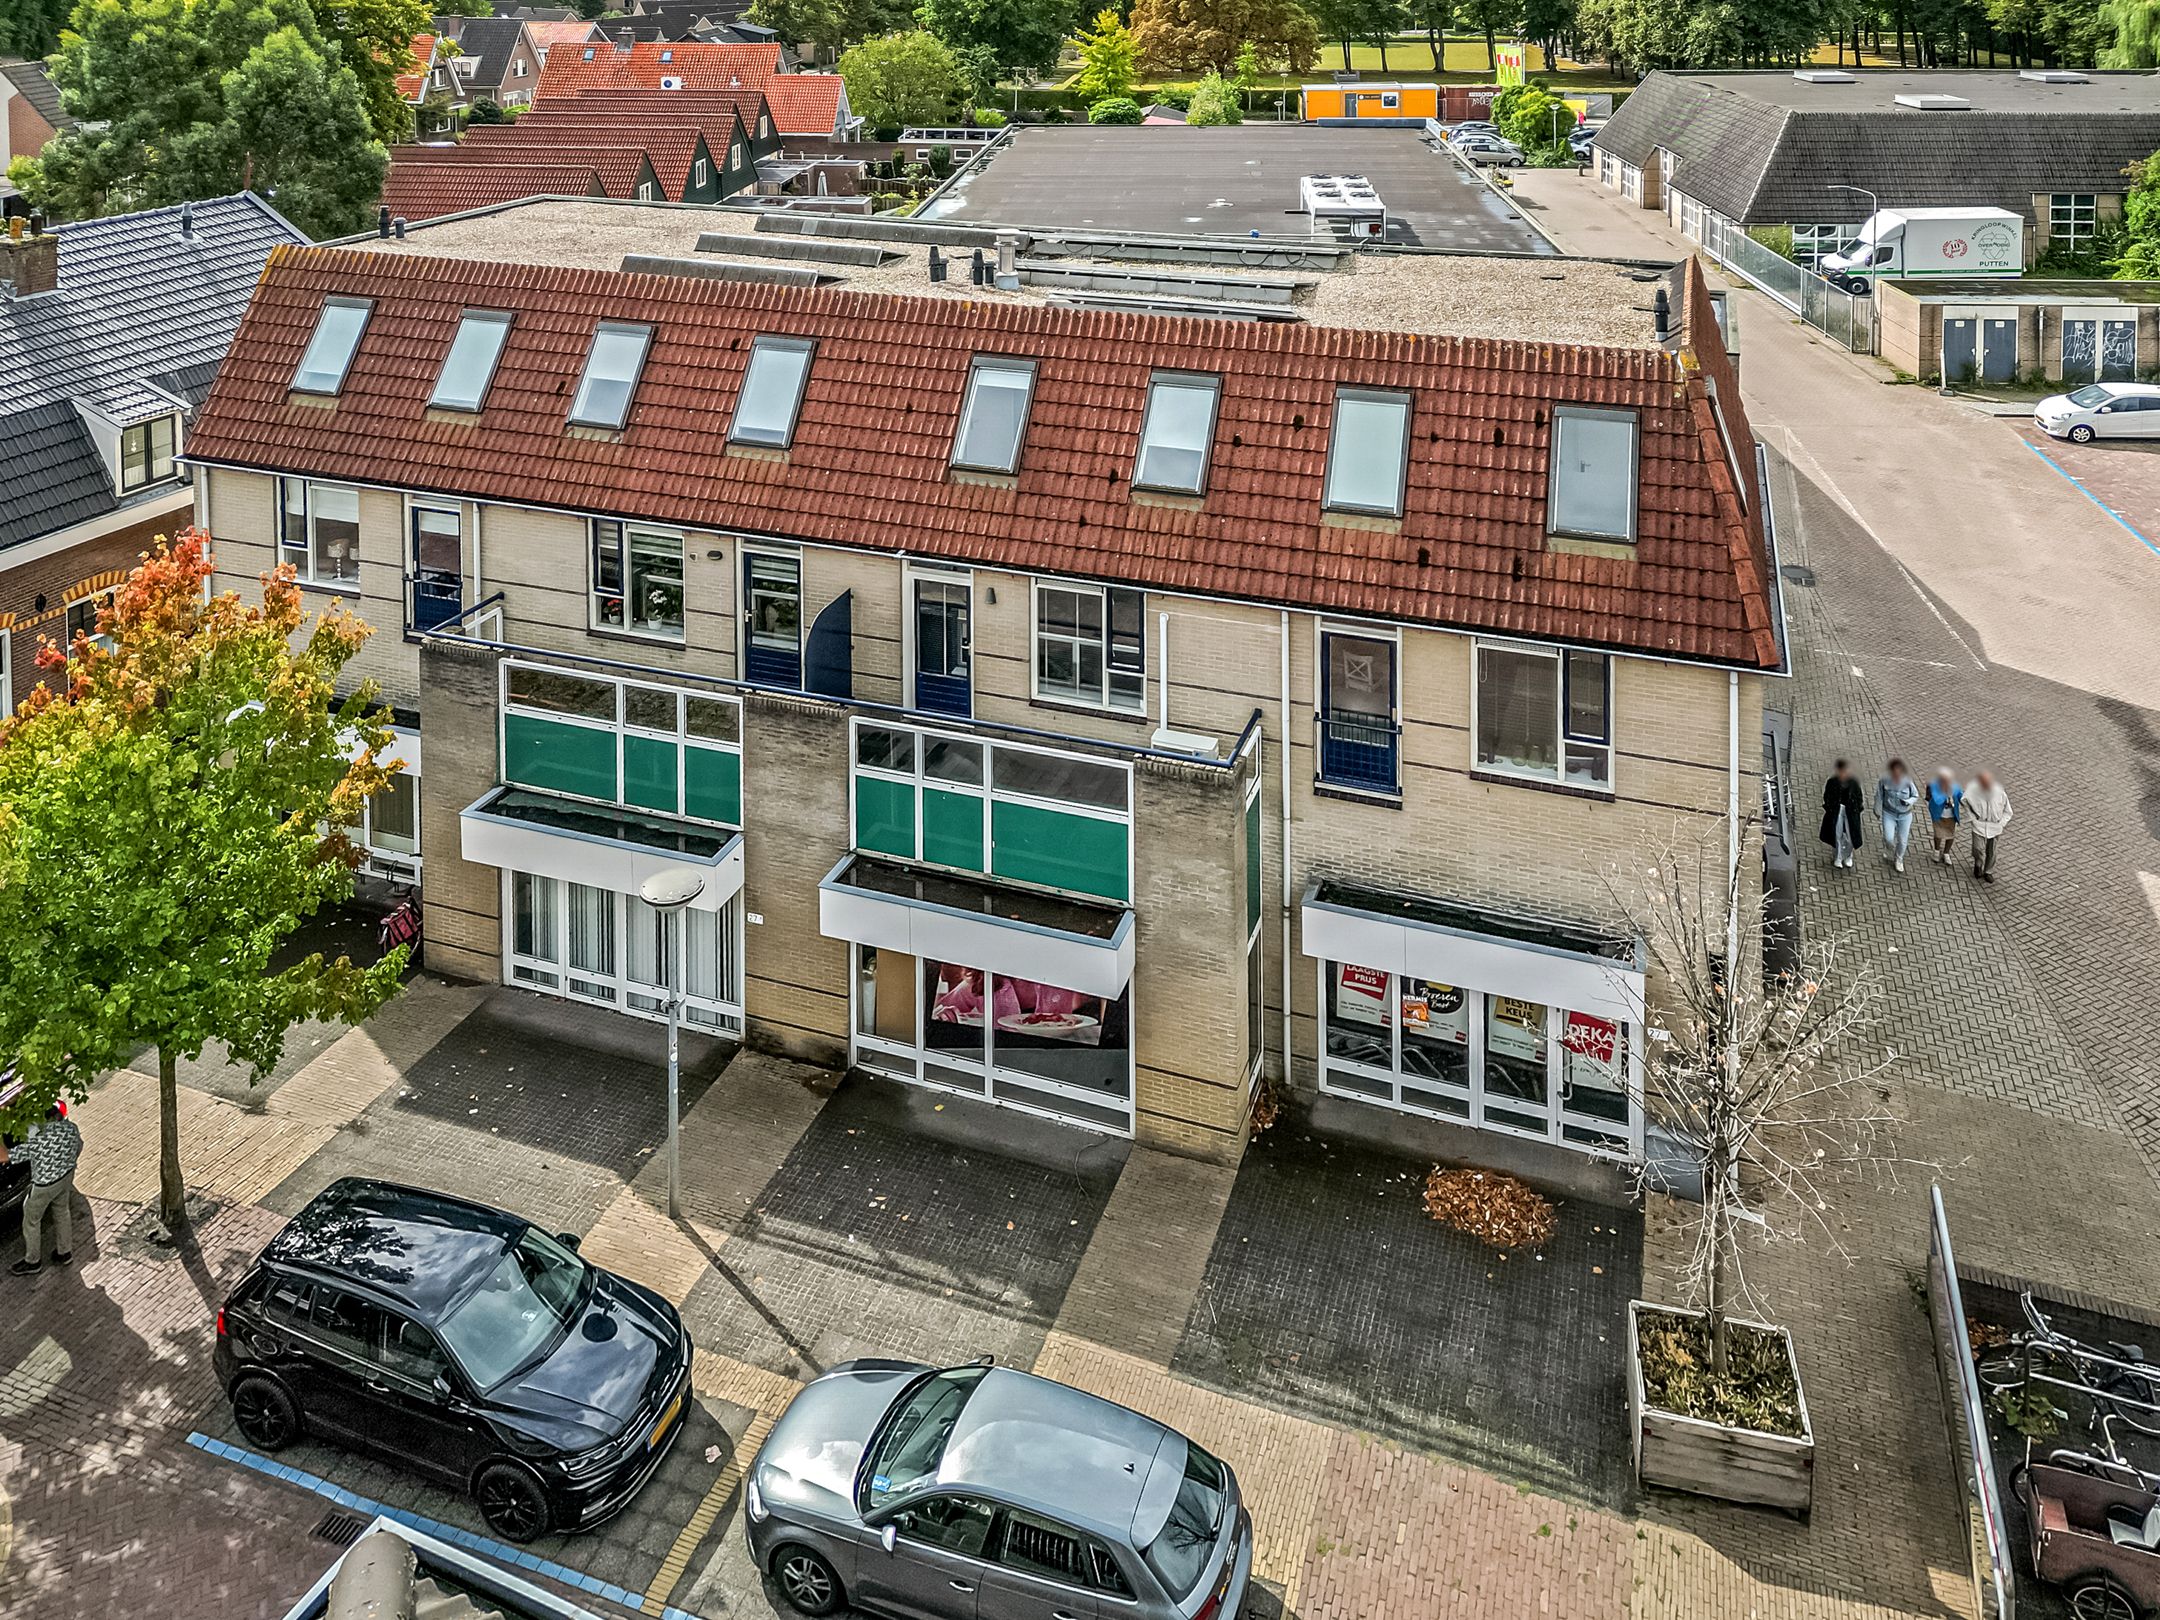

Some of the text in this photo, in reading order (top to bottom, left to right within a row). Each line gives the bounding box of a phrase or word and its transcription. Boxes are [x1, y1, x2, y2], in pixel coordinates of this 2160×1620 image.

[1346, 964, 1386, 978] LAAGSTE
[1504, 997, 1535, 1011] BESTE
[1568, 1023, 1616, 1045] DEKA
[1649, 1029, 1661, 1039] 27
